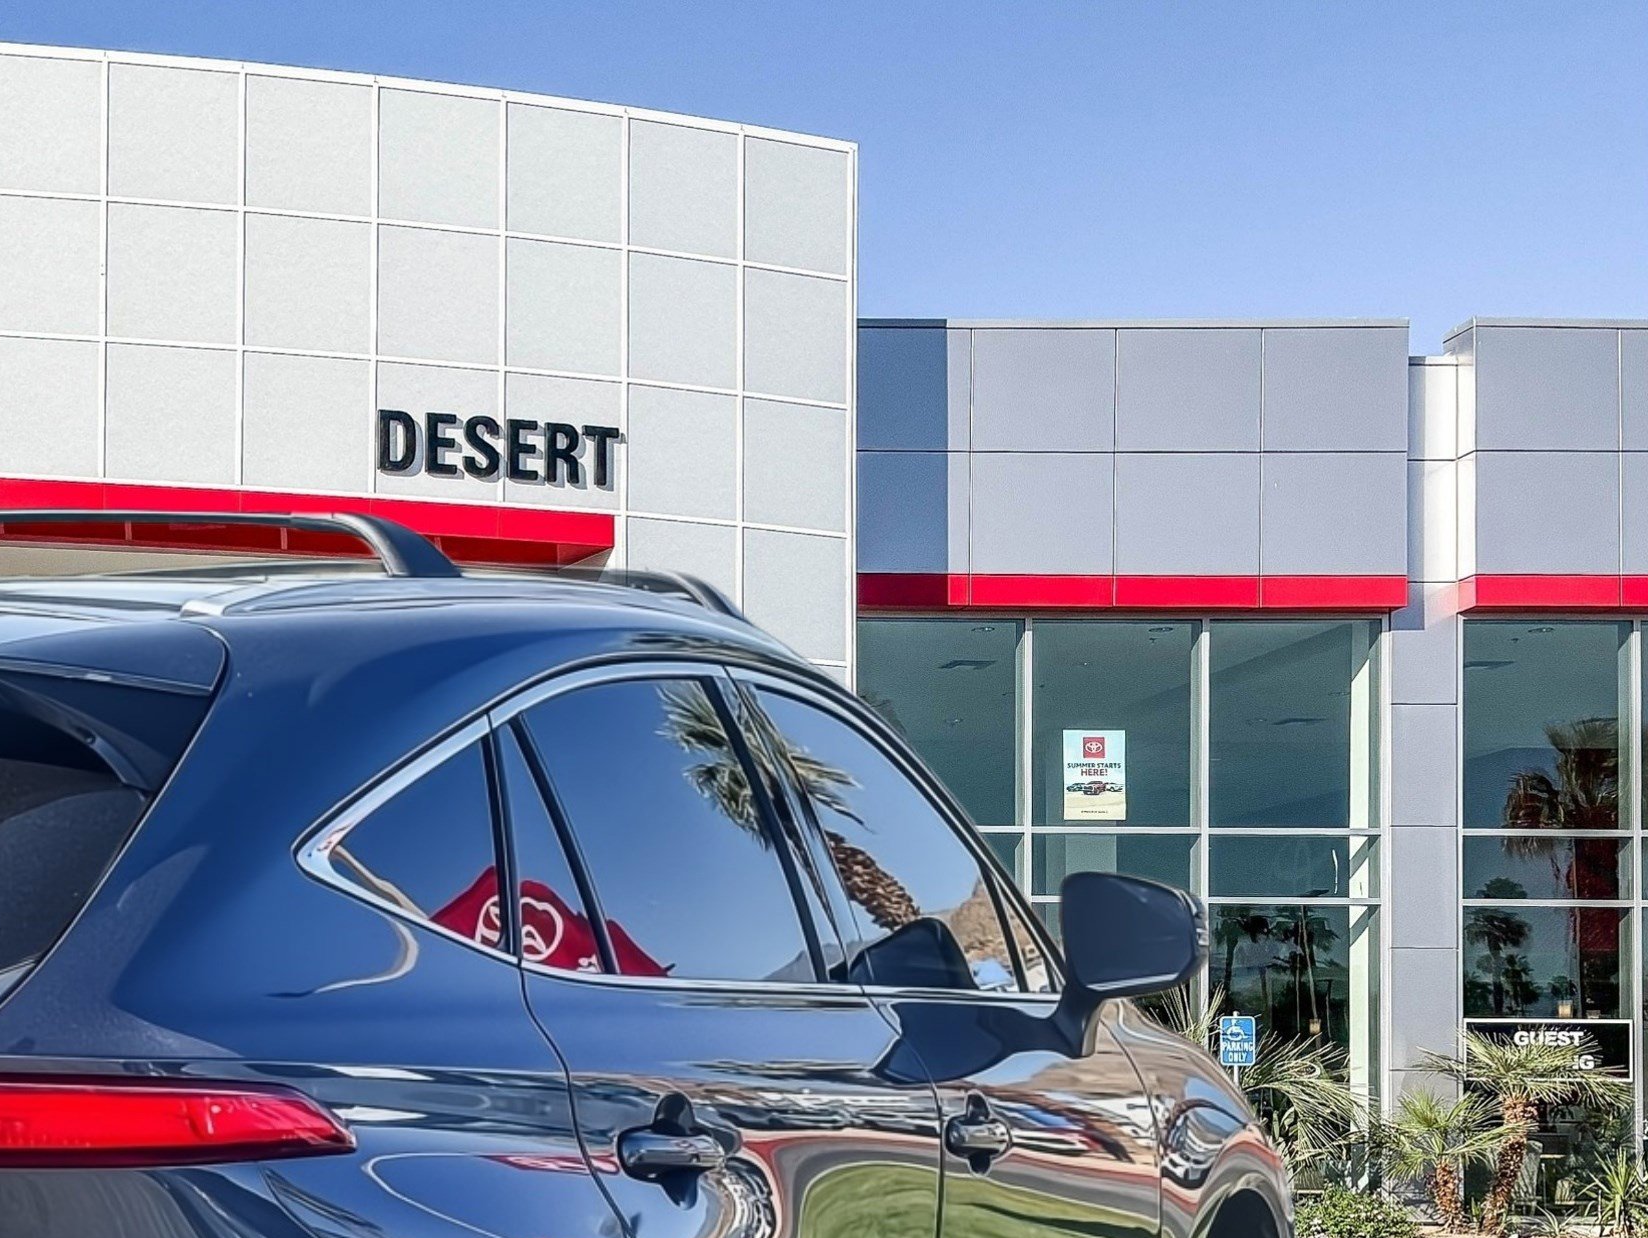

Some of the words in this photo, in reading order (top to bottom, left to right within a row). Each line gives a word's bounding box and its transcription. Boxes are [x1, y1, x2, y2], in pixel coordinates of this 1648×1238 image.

[377, 409, 620, 487] DESERT
[1081, 768, 1108, 777] HERE!
[1513, 1030, 1584, 1047] GUEST
[1222, 1040, 1254, 1052] PARKING
[1228, 1051, 1248, 1062] ONLY
